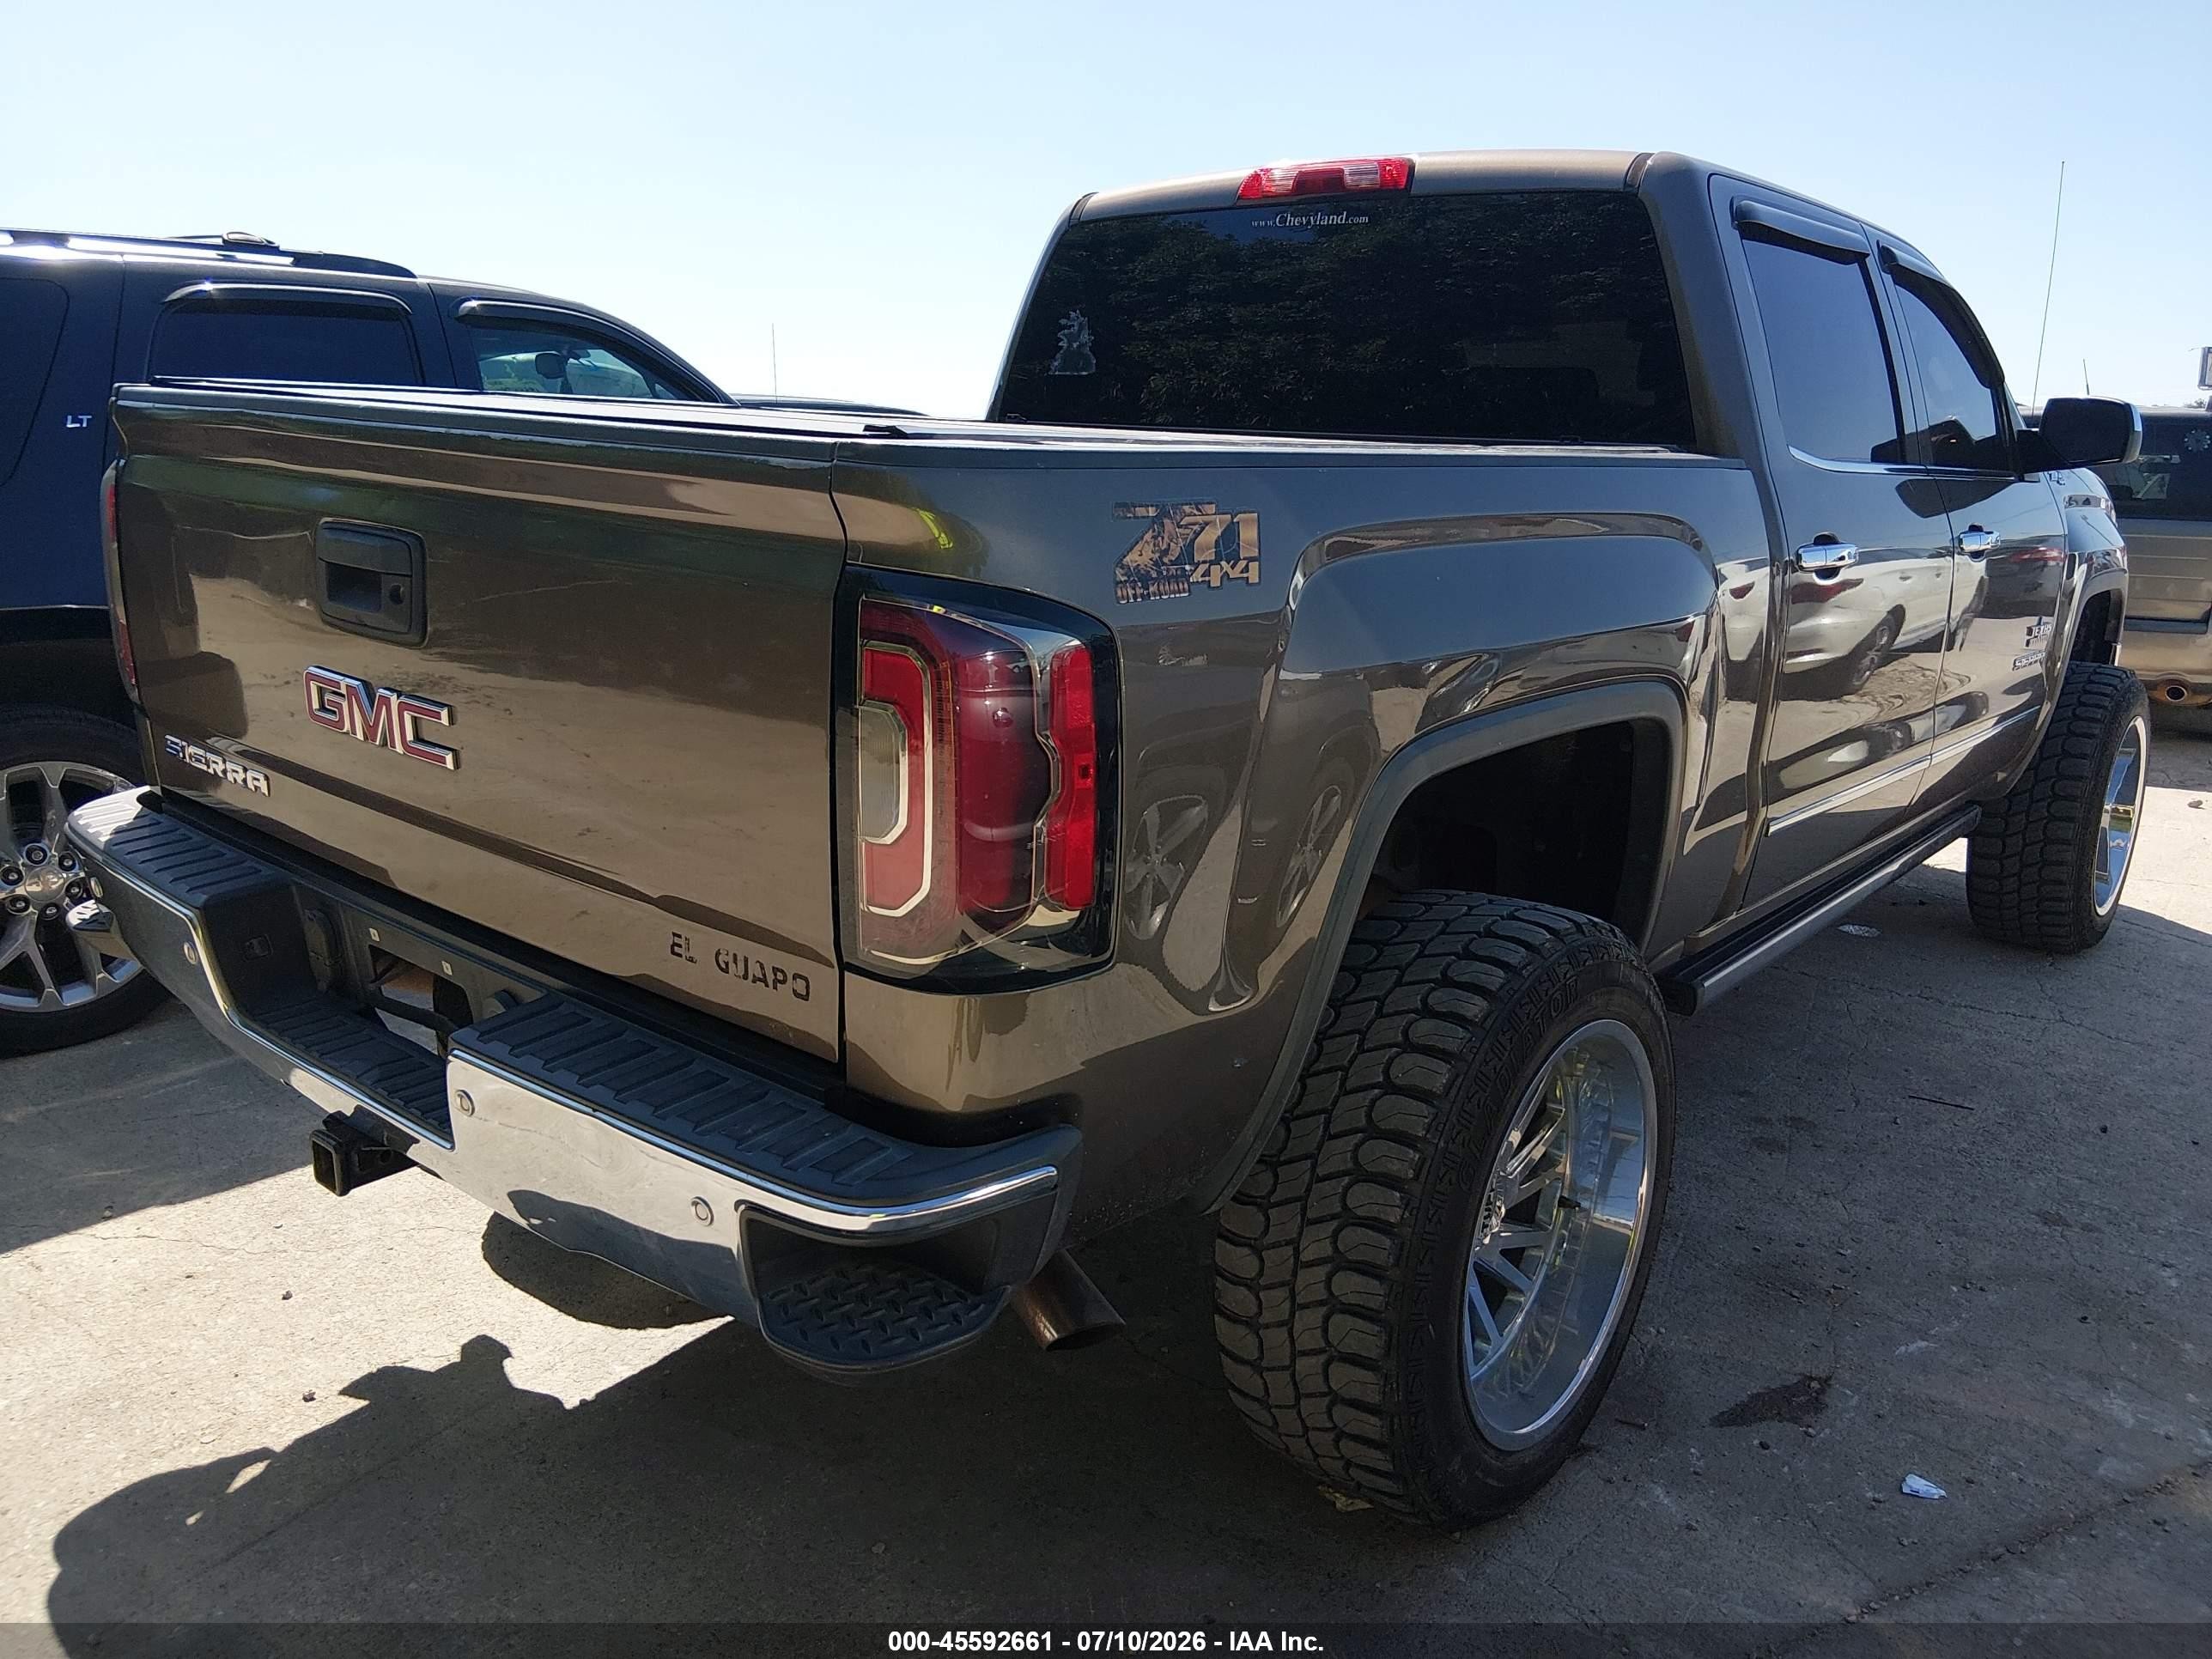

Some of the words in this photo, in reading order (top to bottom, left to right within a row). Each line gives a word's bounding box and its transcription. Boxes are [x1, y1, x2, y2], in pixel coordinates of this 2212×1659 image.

[1251, 211, 1369, 228] www.Chevyland.com
[67, 415, 92, 428] LT
[1113, 501, 1260, 580] Z71
[303, 665, 461, 770] GMC
[164, 734, 270, 797] SIERRA
[669, 931, 698, 964] EL
[714, 948, 811, 1002] GUAPO
